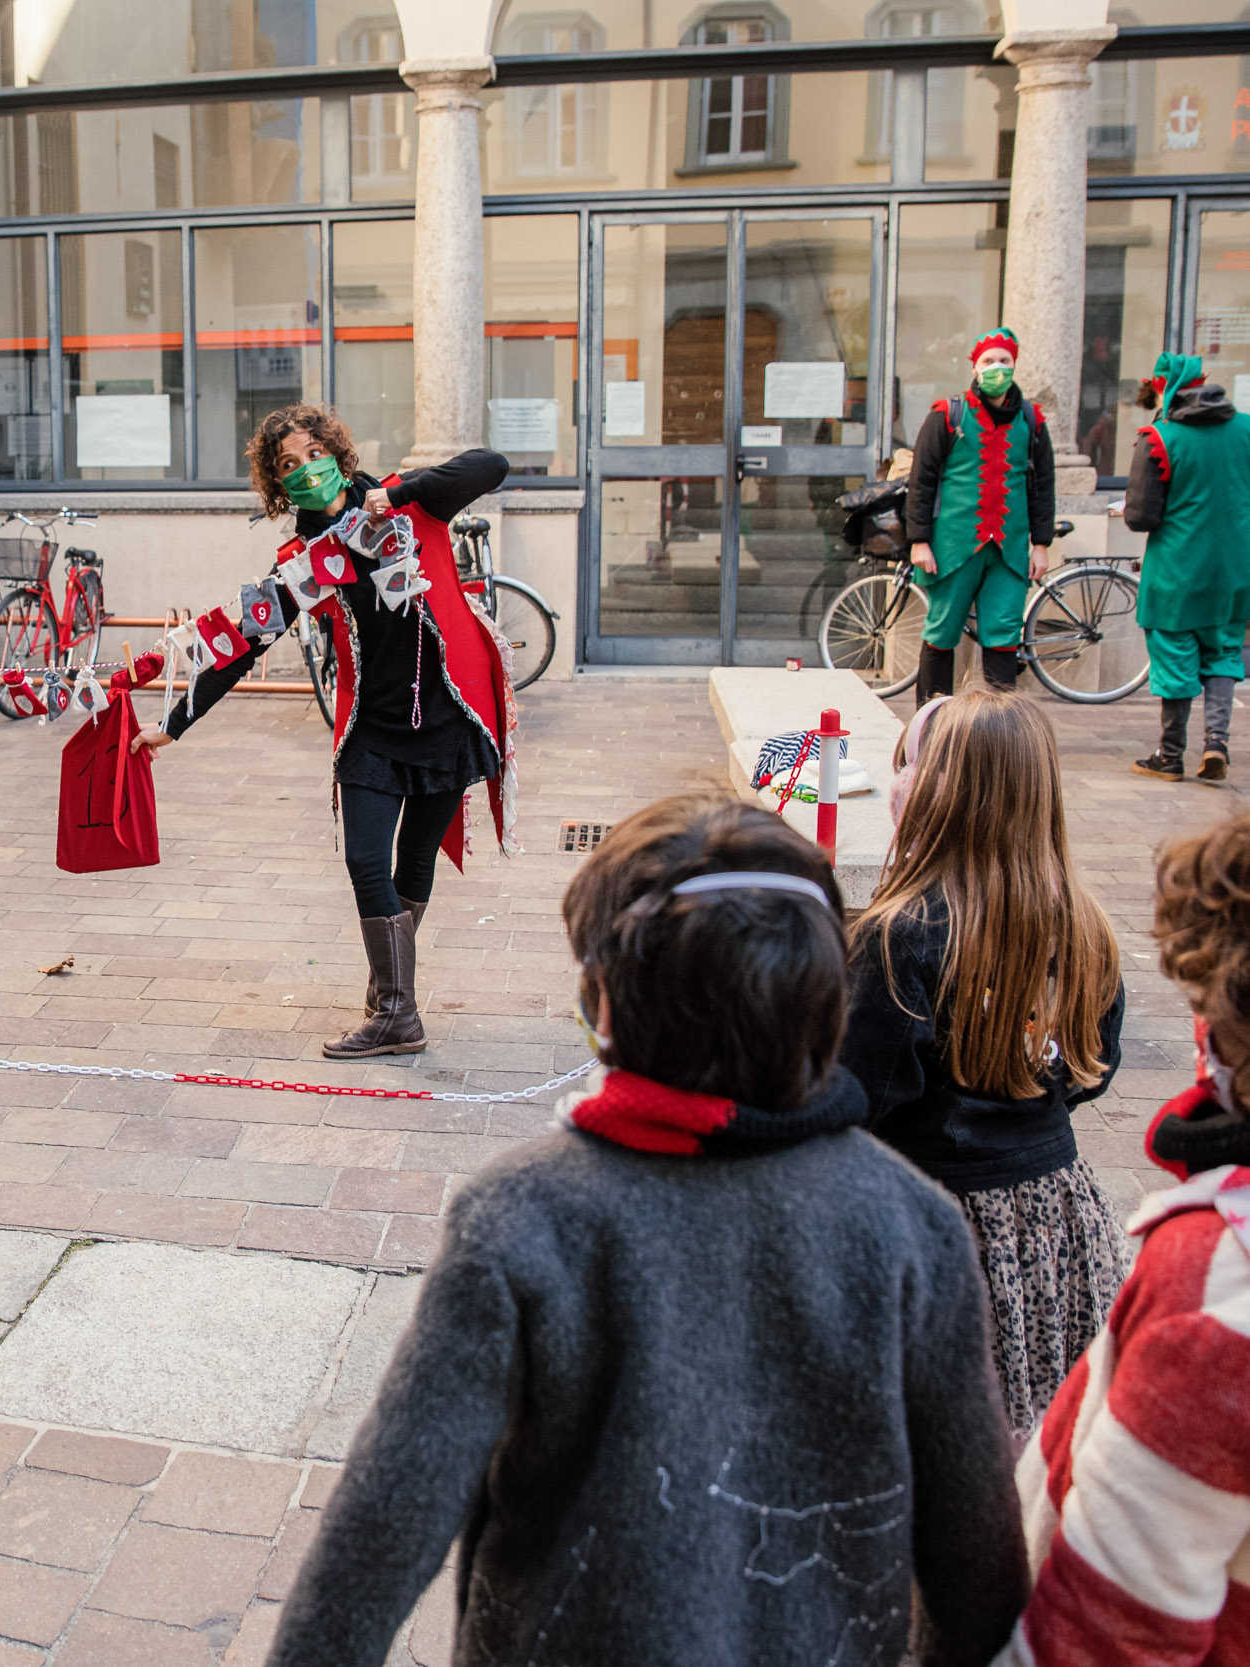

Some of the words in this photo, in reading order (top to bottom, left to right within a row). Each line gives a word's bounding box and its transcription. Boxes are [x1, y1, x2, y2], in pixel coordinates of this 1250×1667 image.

[307, 583, 318, 595] 8
[258, 606, 267, 621] 9
[77, 745, 129, 828] 13
